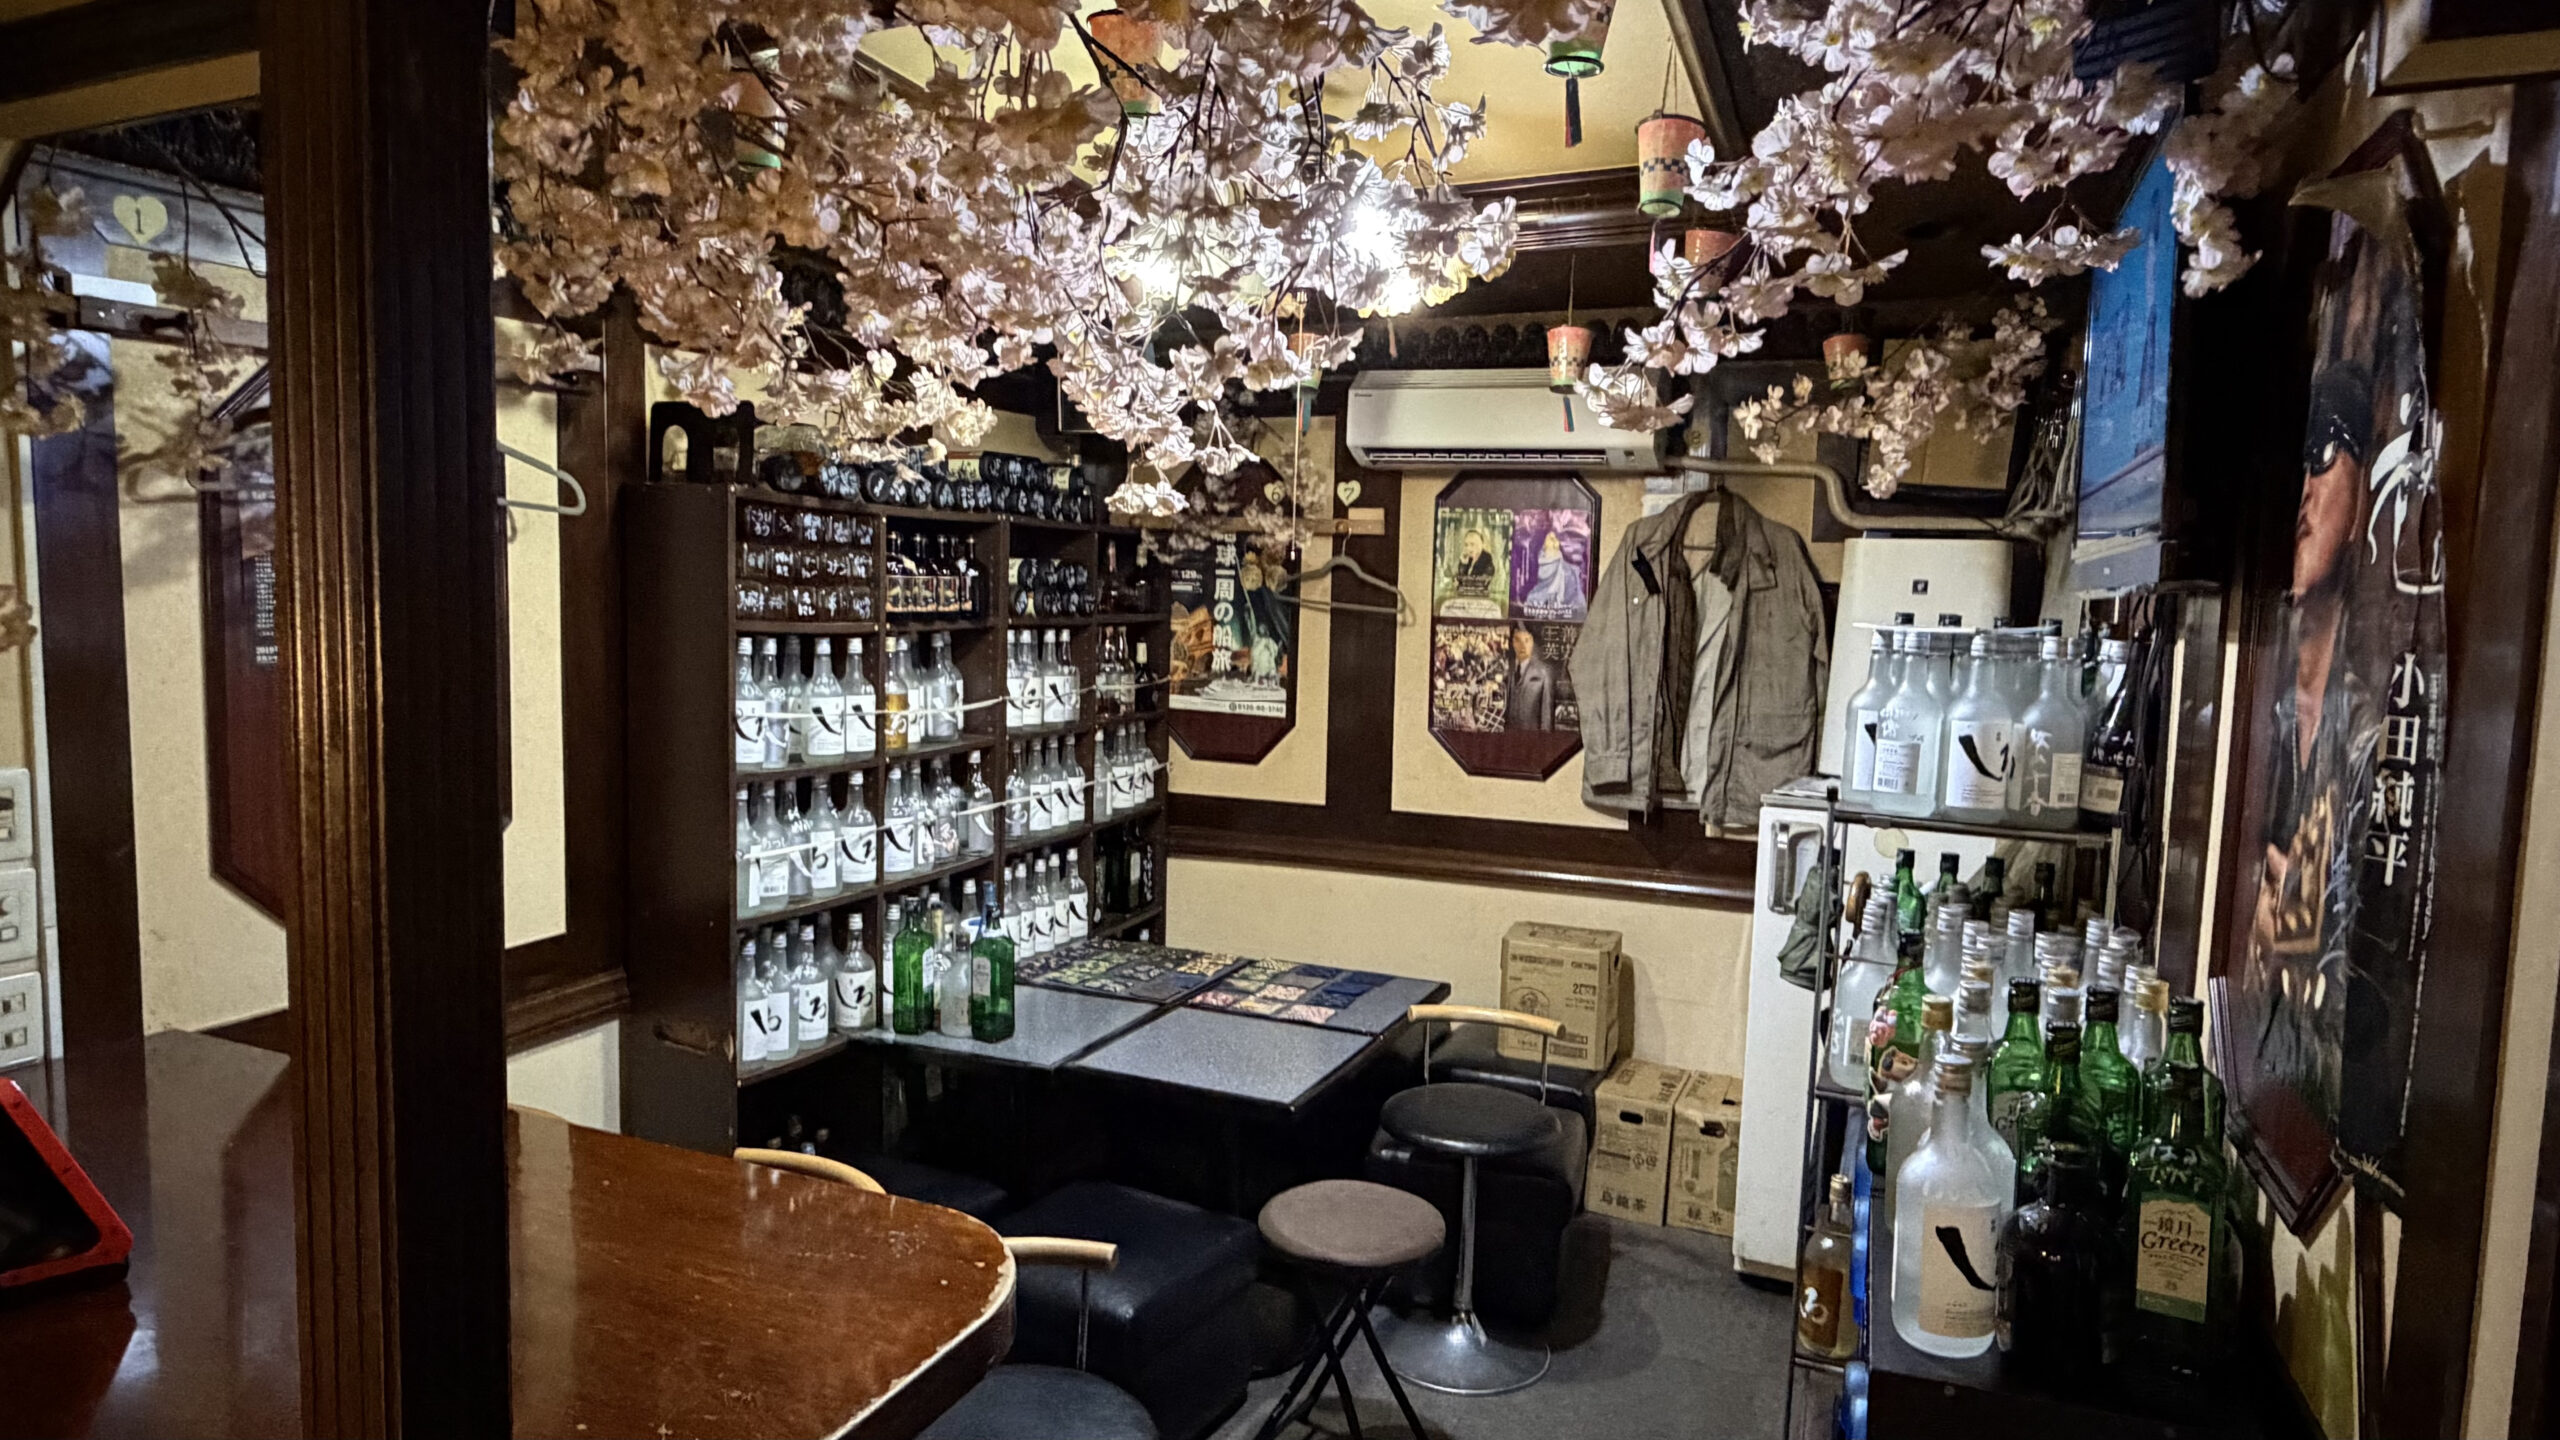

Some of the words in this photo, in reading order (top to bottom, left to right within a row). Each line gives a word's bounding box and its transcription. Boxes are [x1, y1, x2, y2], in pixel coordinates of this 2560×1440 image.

[134, 208, 144, 235] 1
[1271, 486, 1281, 502] 6
[1344, 487, 1355, 501] 7
[2364, 651, 2425, 887] 小田純平
[2141, 1231, 2207, 1259] Green
